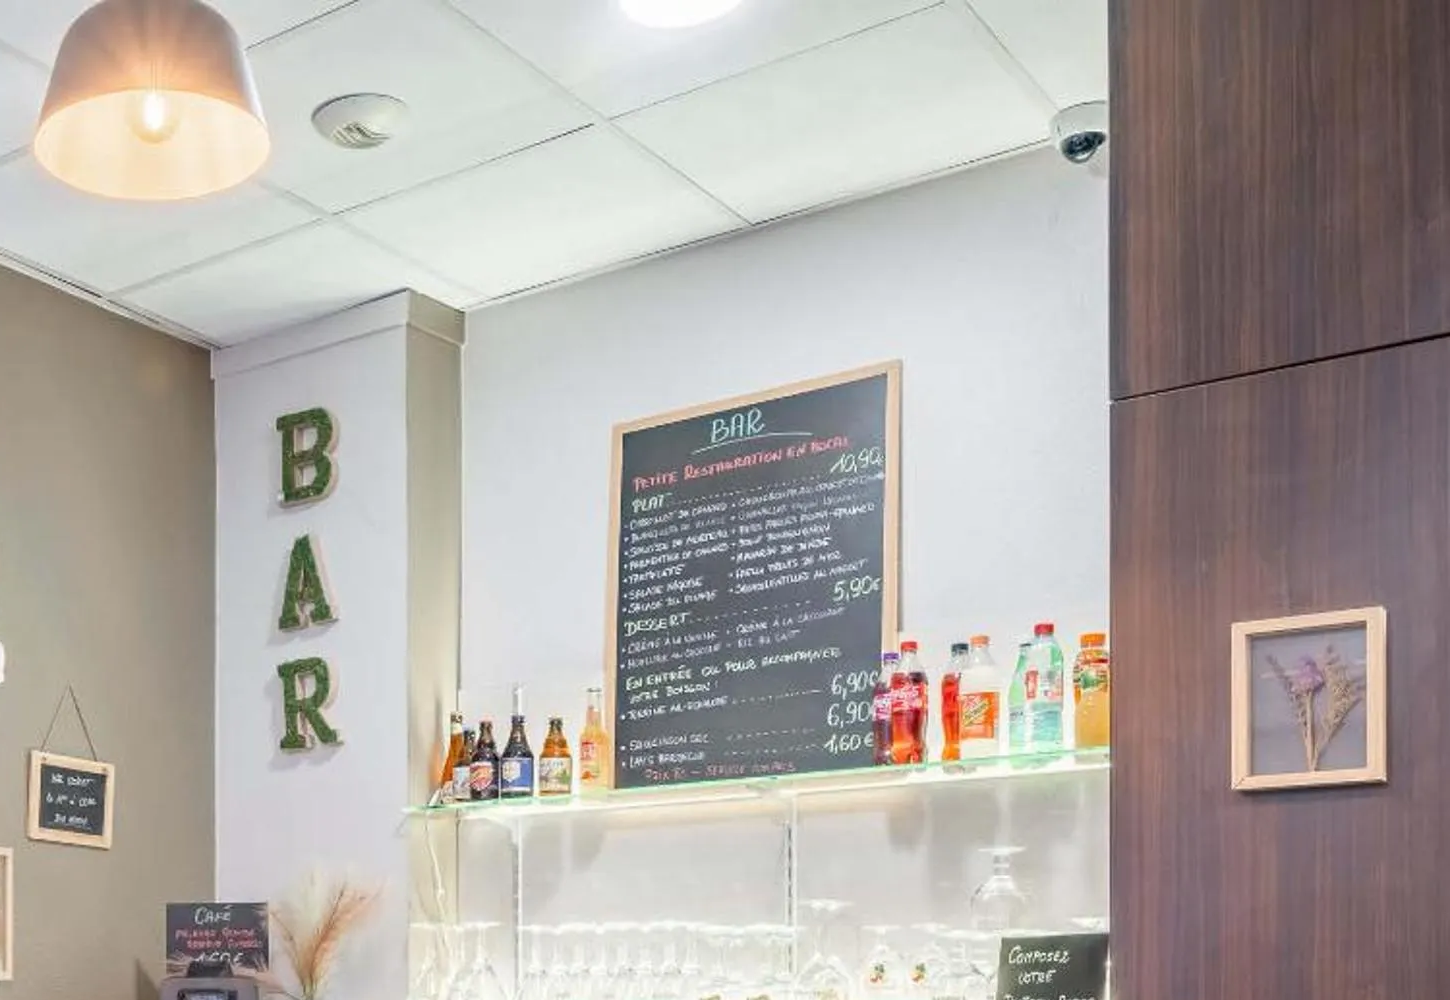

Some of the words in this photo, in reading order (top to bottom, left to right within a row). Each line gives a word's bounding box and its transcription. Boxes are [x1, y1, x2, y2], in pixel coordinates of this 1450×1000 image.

[710, 408, 766, 444] BAR
[632, 471, 679, 493] PETITE
[786, 443, 807, 458] EN
[631, 492, 673, 513] PLAT
[276, 407, 345, 753] BAR
[624, 611, 693, 637] DESSERT
[1008, 944, 1071, 964] COMPOSEZ
[1018, 969, 1057, 985] VOTRE
